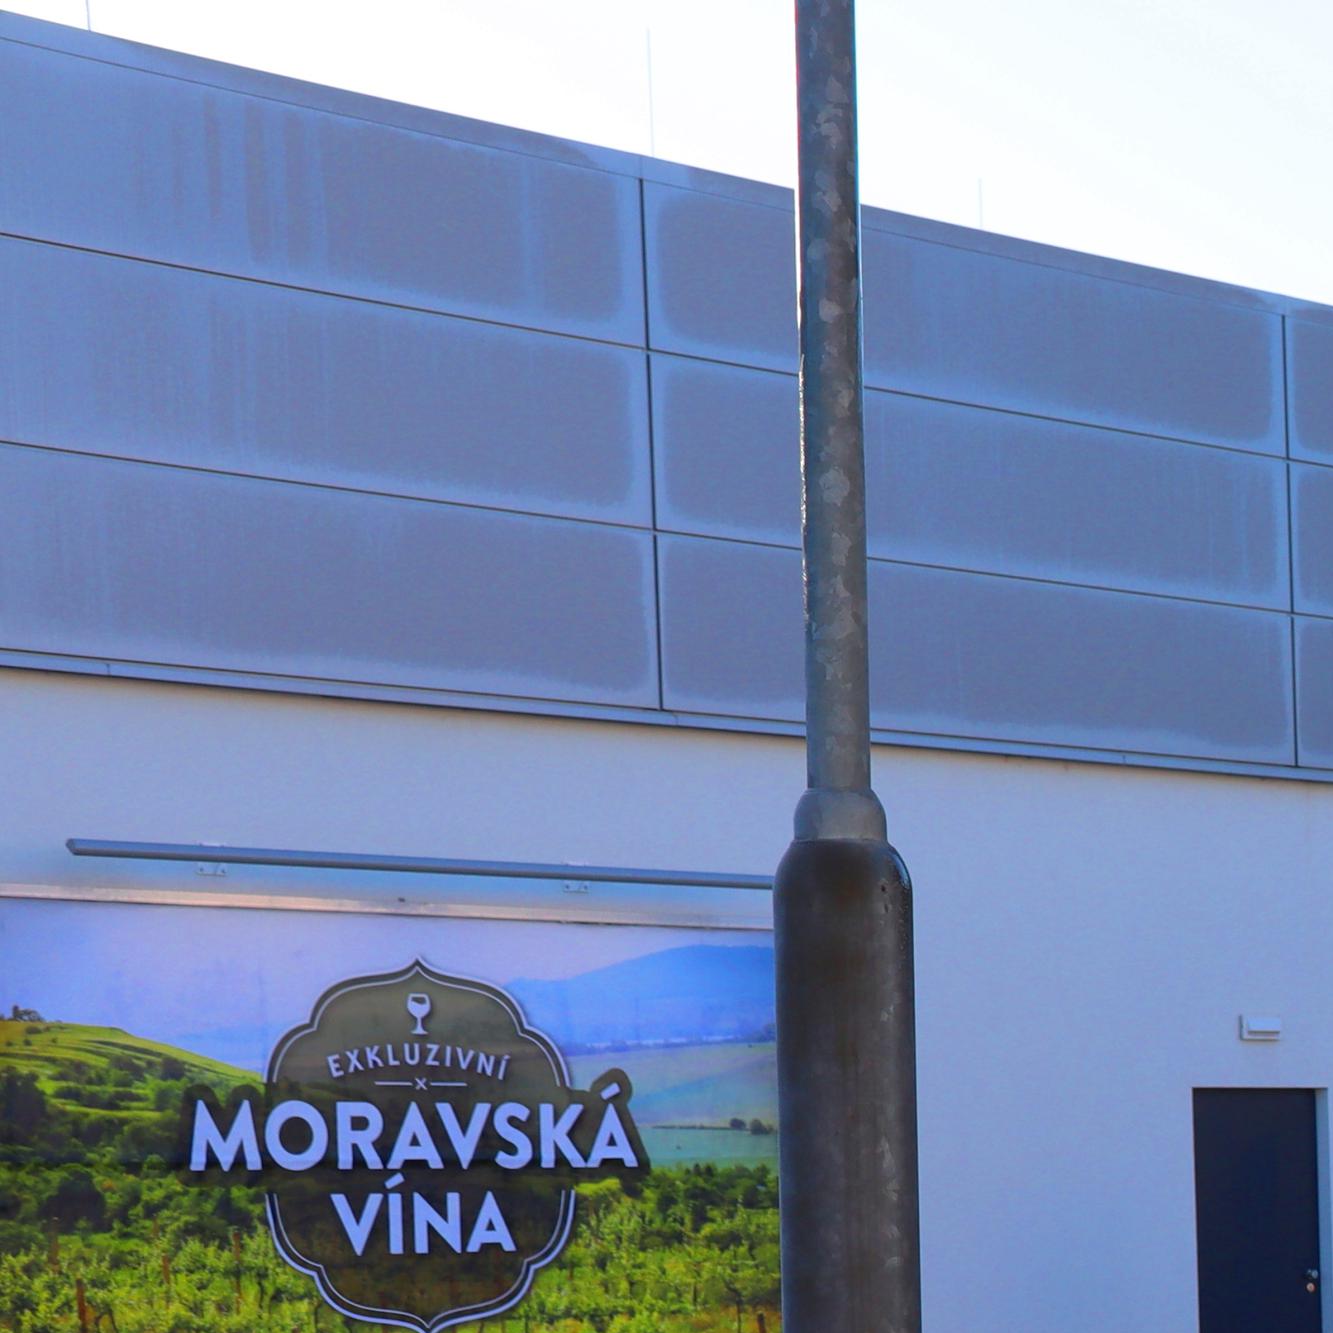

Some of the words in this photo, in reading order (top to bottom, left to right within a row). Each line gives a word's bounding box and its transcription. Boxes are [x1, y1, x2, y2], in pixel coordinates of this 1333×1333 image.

[326, 1043, 512, 1080] EXKLUZIVNÍ
[189, 1082, 639, 1172] MORAVSKÁ
[331, 1173, 517, 1257] VÍNA
